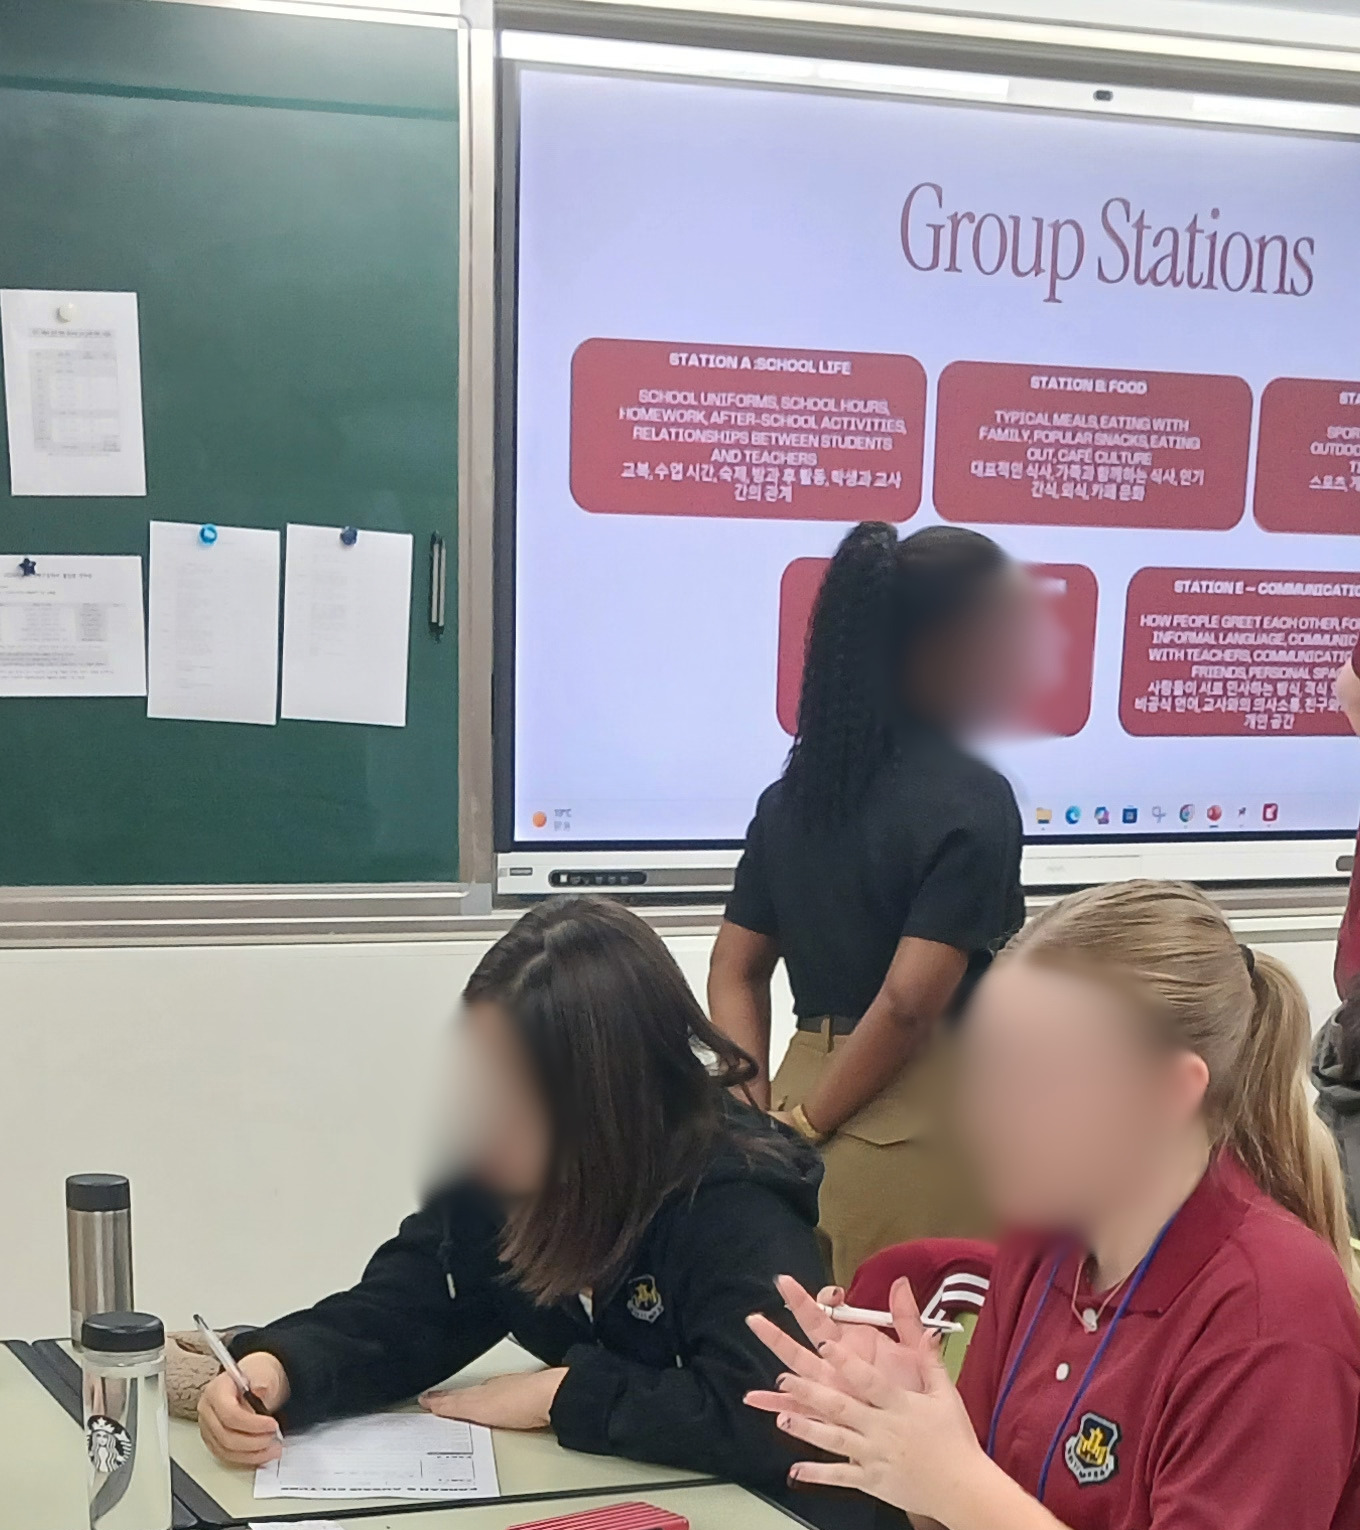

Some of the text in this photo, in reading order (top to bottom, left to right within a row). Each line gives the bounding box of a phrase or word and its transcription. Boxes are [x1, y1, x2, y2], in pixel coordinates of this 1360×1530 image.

[900, 181, 1315, 304] Group Stations
[669, 352, 738, 369] STATION
[740, 356, 751, 370] A
[818, 360, 852, 375] LIFE
[1030, 376, 1093, 392] STATION
[1109, 380, 1148, 395] FOOD
[639, 389, 698, 405] SCHOOL
[700, 391, 779, 410] UNIFORMS,
[781, 395, 839, 412] SCHOOL
[820, 416, 907, 435] ACTIVITIES,
[994, 410, 1051, 426] TYPICAL
[1100, 415, 1151, 431] EATING
[1152, 417, 1189, 432] WITH
[633, 426, 893, 450] RELATIONSHIPS BETWEEN STUDENTS
[979, 426, 1032, 444] FAMILY,
[1034, 429, 1093, 445] POPULAR
[1150, 435, 1200, 450] EATING
[711, 448, 818, 466] AND TEACHERS
[1026, 447, 1057, 464] OUT,
[1094, 450, 1152, 466] CULTURE
[654, 461, 683, 481] 수업
[874, 471, 902, 489] 교사
[970, 460, 1023, 479] 대표적인
[1180, 468, 1204, 486] 인기
[734, 483, 793, 502] 간의 관계
[1174, 580, 1235, 595] STATION
[1235, 581, 1244, 595] E
[1140, 614, 1173, 628] HOW
[1173, 615, 1220, 629] PEOPLE
[1221, 615, 1262, 629] GREET
[1263, 616, 1298, 630] EACH
[1152, 631, 1217, 645] INFORMAL
[1288, 633, 1359, 647] COMMUNIC
[1148, 648, 1185, 661] WITH
[1248, 666, 1311, 680] PERSONAL
[1226, 680, 1274, 697] 인사하는
